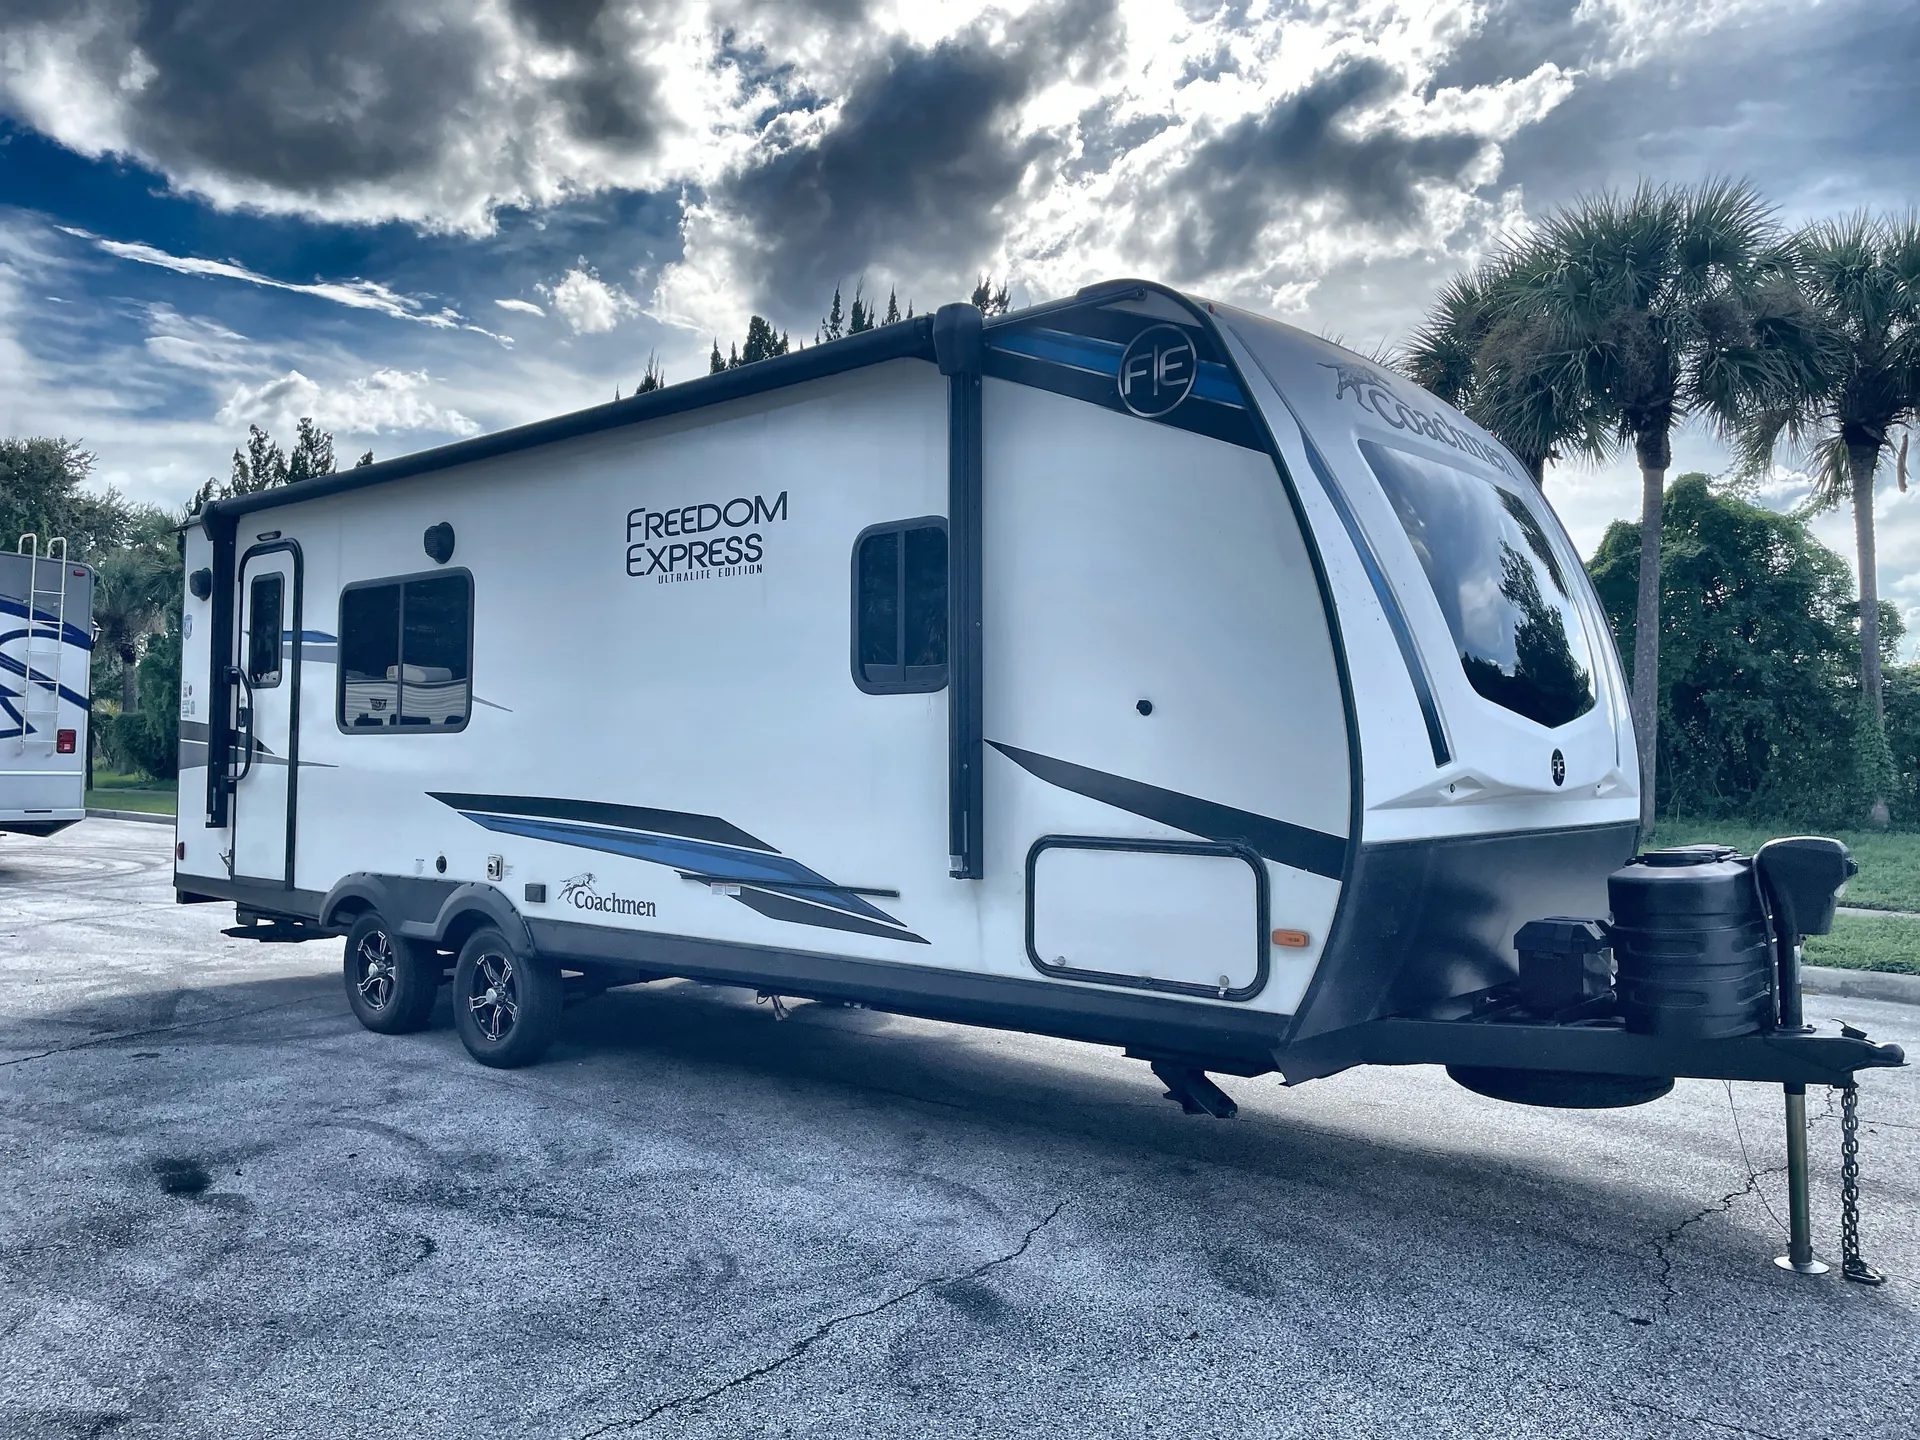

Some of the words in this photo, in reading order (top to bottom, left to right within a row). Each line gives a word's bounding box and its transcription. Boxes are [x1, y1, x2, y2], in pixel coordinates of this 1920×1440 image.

[1368, 389, 1519, 481] Coachmen
[626, 490, 788, 543] FREEDOM
[626, 533, 763, 577] EXPRESS
[658, 569, 711, 585] ULTRALITE
[718, 563, 763, 578] EDITION
[574, 890, 657, 917] Coachmen
